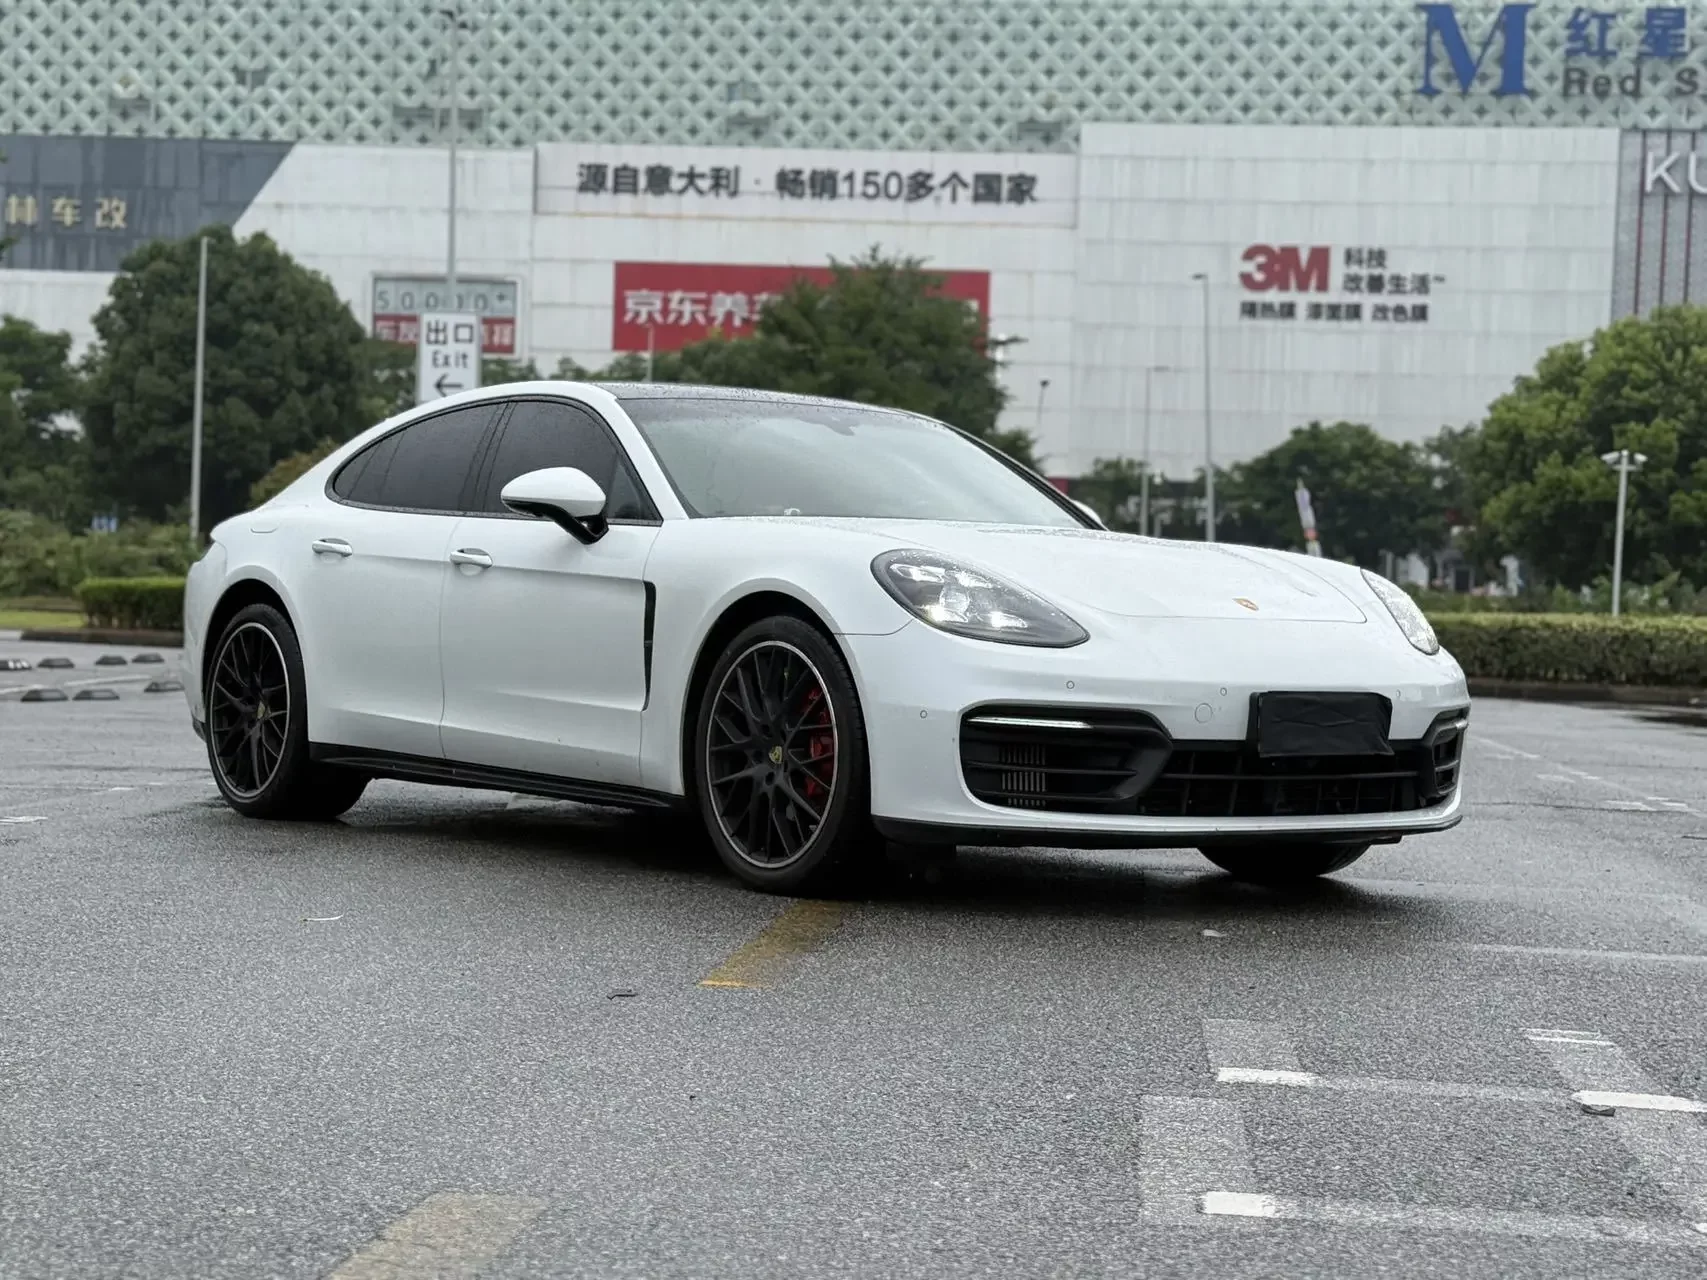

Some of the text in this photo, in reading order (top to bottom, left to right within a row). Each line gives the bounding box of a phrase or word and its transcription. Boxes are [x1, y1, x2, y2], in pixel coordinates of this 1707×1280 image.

[1415, 4, 1536, 96] M
[1565, 7, 1688, 57] 红星
[1563, 60, 1641, 98] Red
[1239, 244, 1331, 292] 3M
[1343, 247, 1387, 269] 科技
[426, 320, 474, 345] 出口
[432, 350, 469, 368] Exit
